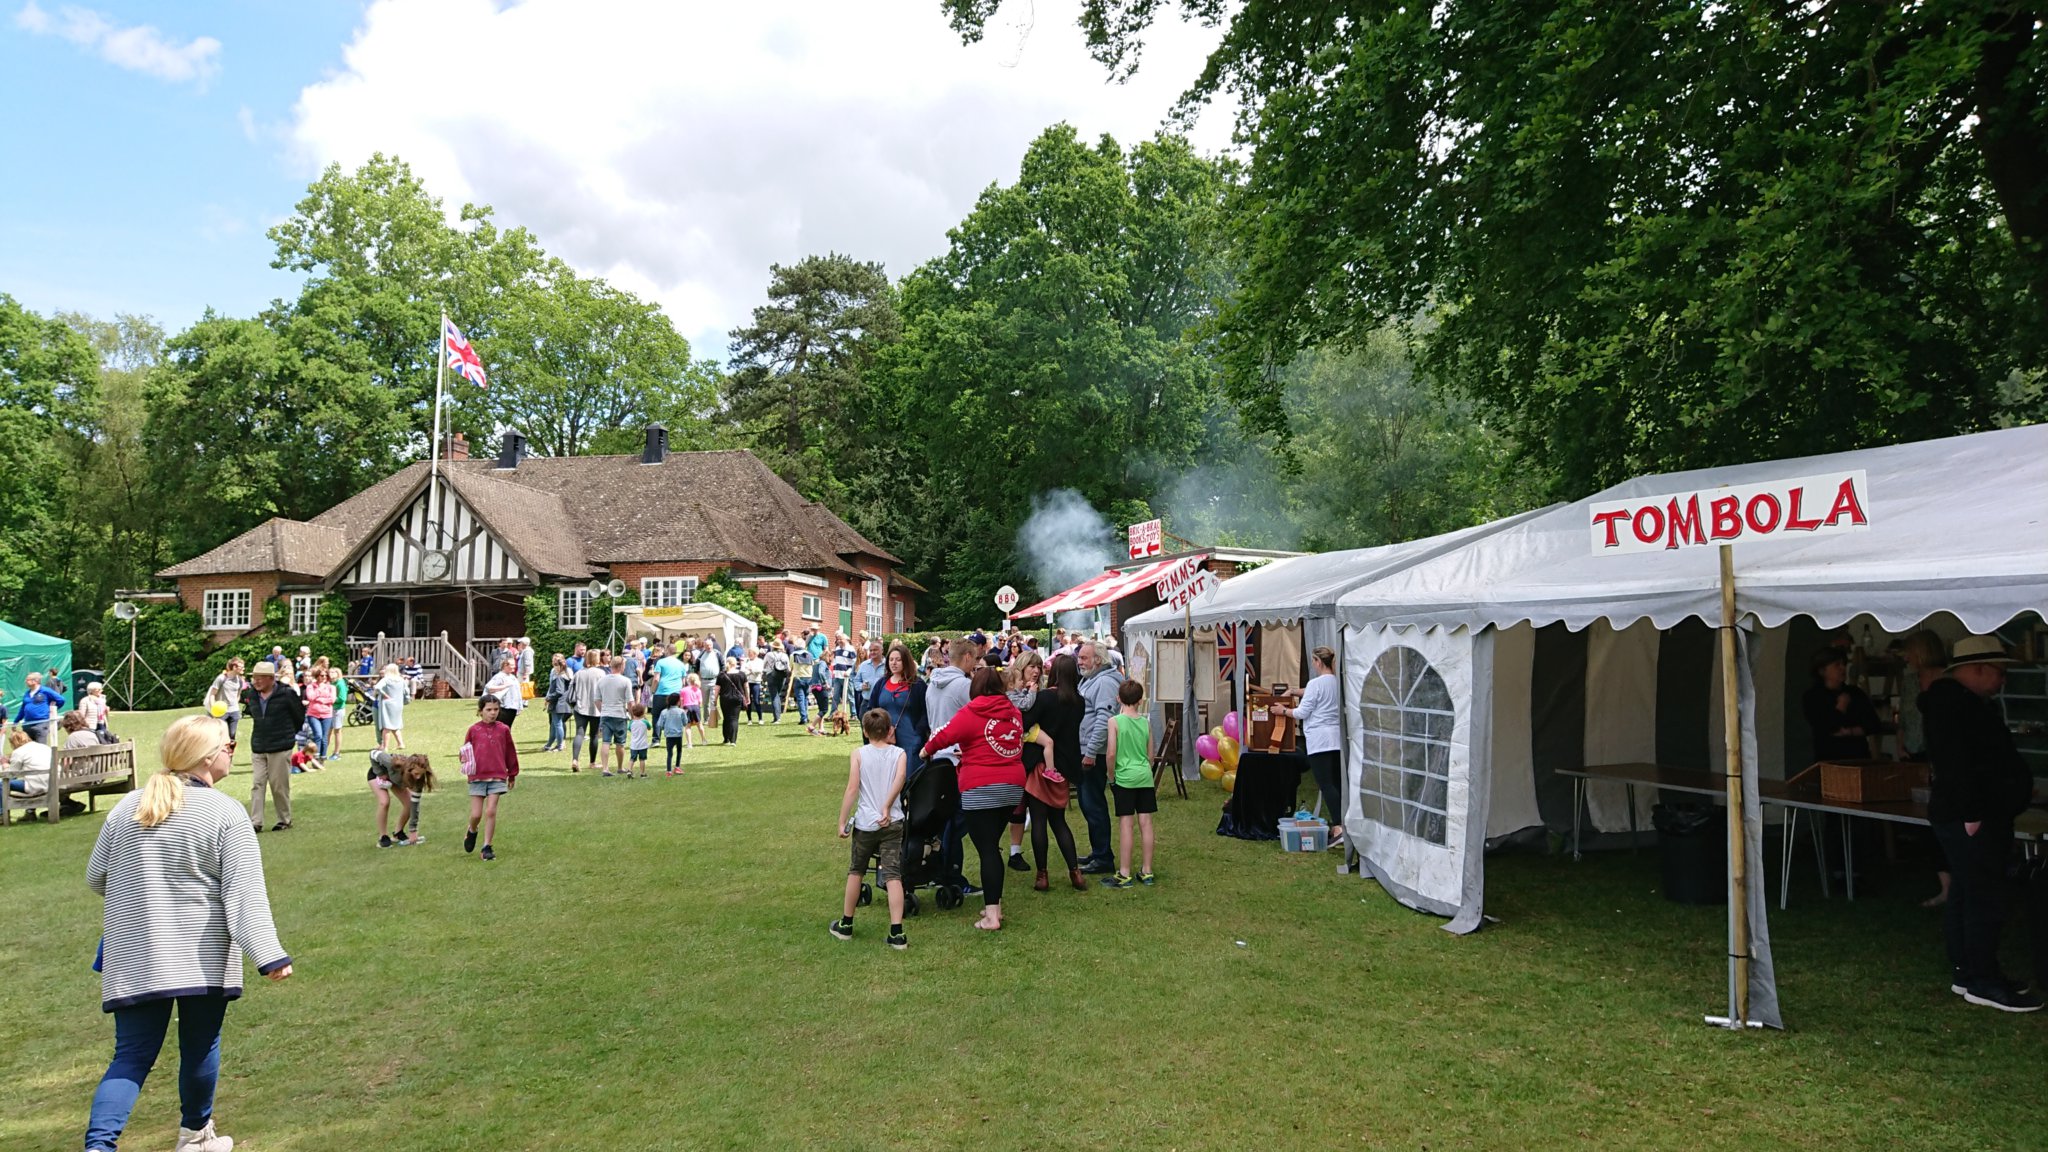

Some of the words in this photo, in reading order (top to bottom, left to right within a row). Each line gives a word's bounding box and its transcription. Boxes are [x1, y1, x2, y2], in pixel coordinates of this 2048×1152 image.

[1592, 477, 1867, 550] TOMBOLA
[1158, 558, 1196, 599] PIMM'S
[1170, 576, 1205, 611] TENT
[998, 593, 1016, 605] BBQ
[988, 735, 1020, 755] CALIFORNIA
